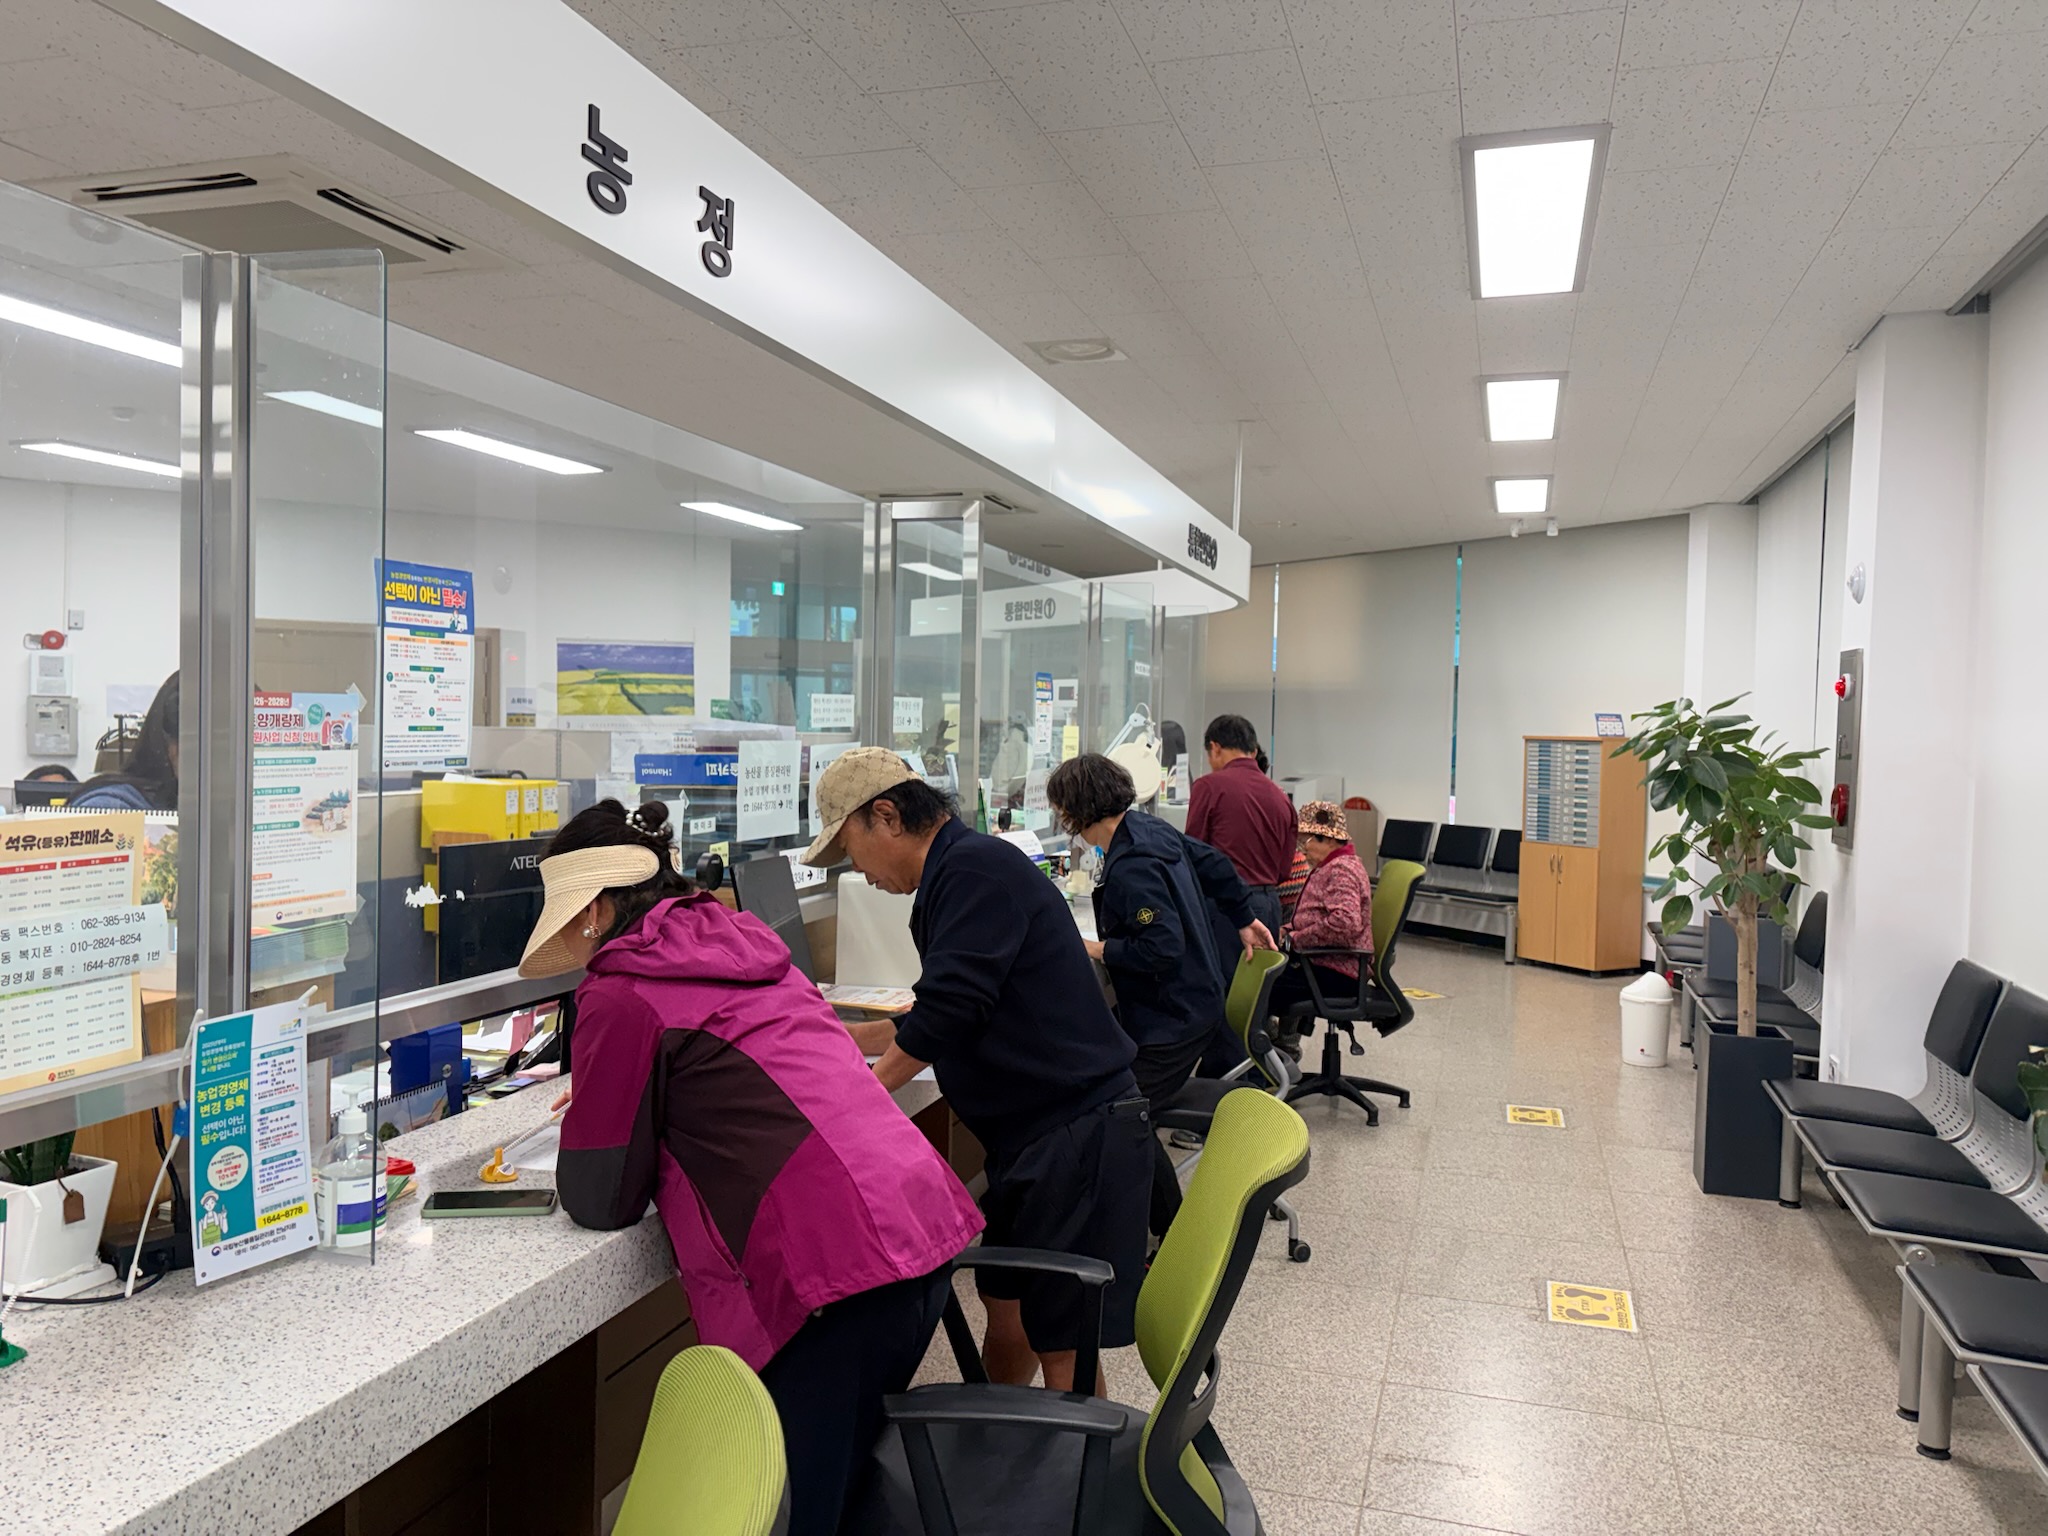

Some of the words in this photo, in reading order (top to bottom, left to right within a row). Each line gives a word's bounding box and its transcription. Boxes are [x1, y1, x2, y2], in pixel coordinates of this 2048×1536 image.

[385, 581, 417, 602] 선택이
[420, 586, 441, 605] 아닌
[442, 587, 467, 609] 필수!
[744, 766, 762, 779] 농산물
[751, 800, 777, 812] 1644-8778
[5, 828, 114, 852] 석유(등유)판매소
[18, 922, 64, 939] 팩스번호
[81, 911, 146, 930] 062-385-9134
[19, 945, 53, 961] 복지폰
[70, 933, 142, 953] 010-2824-8254
[42, 965, 64, 980] 등록
[82, 952, 140, 973] 1644-8778후
[147, 950, 160, 962] 1번
[197, 1077, 249, 1103] 농업경영체
[200, 1101, 221, 1118] 변경
[224, 1094, 245, 1111] 등록
[200, 1125, 247, 1145] 필수입니다!
[202, 1118, 227, 1134] 선택이
[228, 1114, 245, 1127] 아닌
[262, 1206, 303, 1225] 1644-8778
